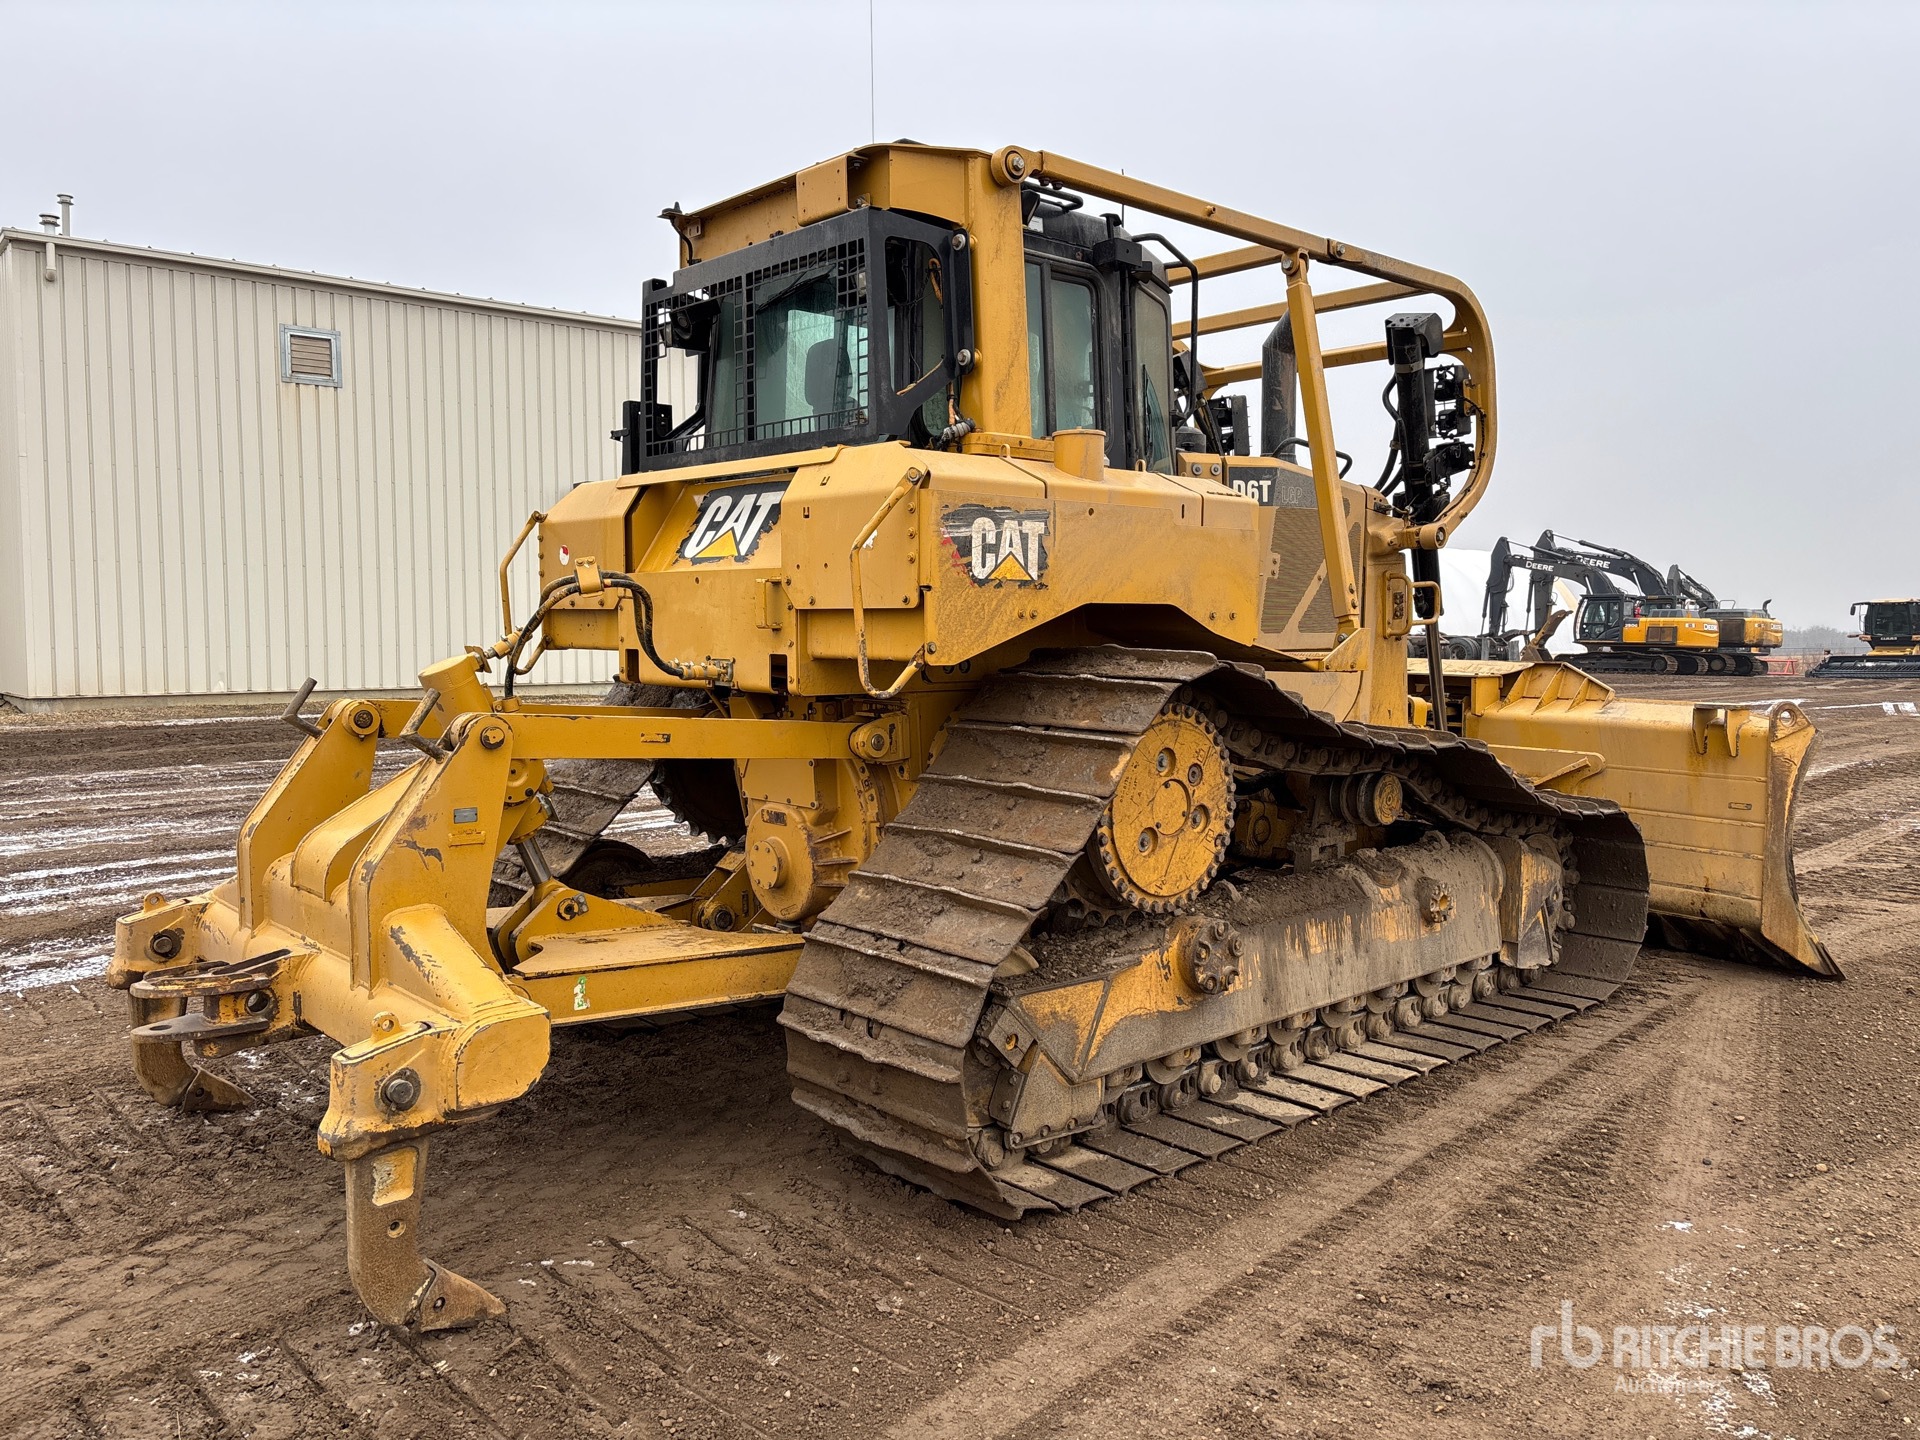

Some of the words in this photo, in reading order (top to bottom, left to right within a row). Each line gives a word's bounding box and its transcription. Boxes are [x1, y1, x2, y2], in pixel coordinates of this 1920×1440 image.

[1233, 479, 1272, 503] D6T
[684, 490, 786, 559] CAT
[970, 516, 1045, 581] CAT
[1525, 560, 1555, 572] DEERE
